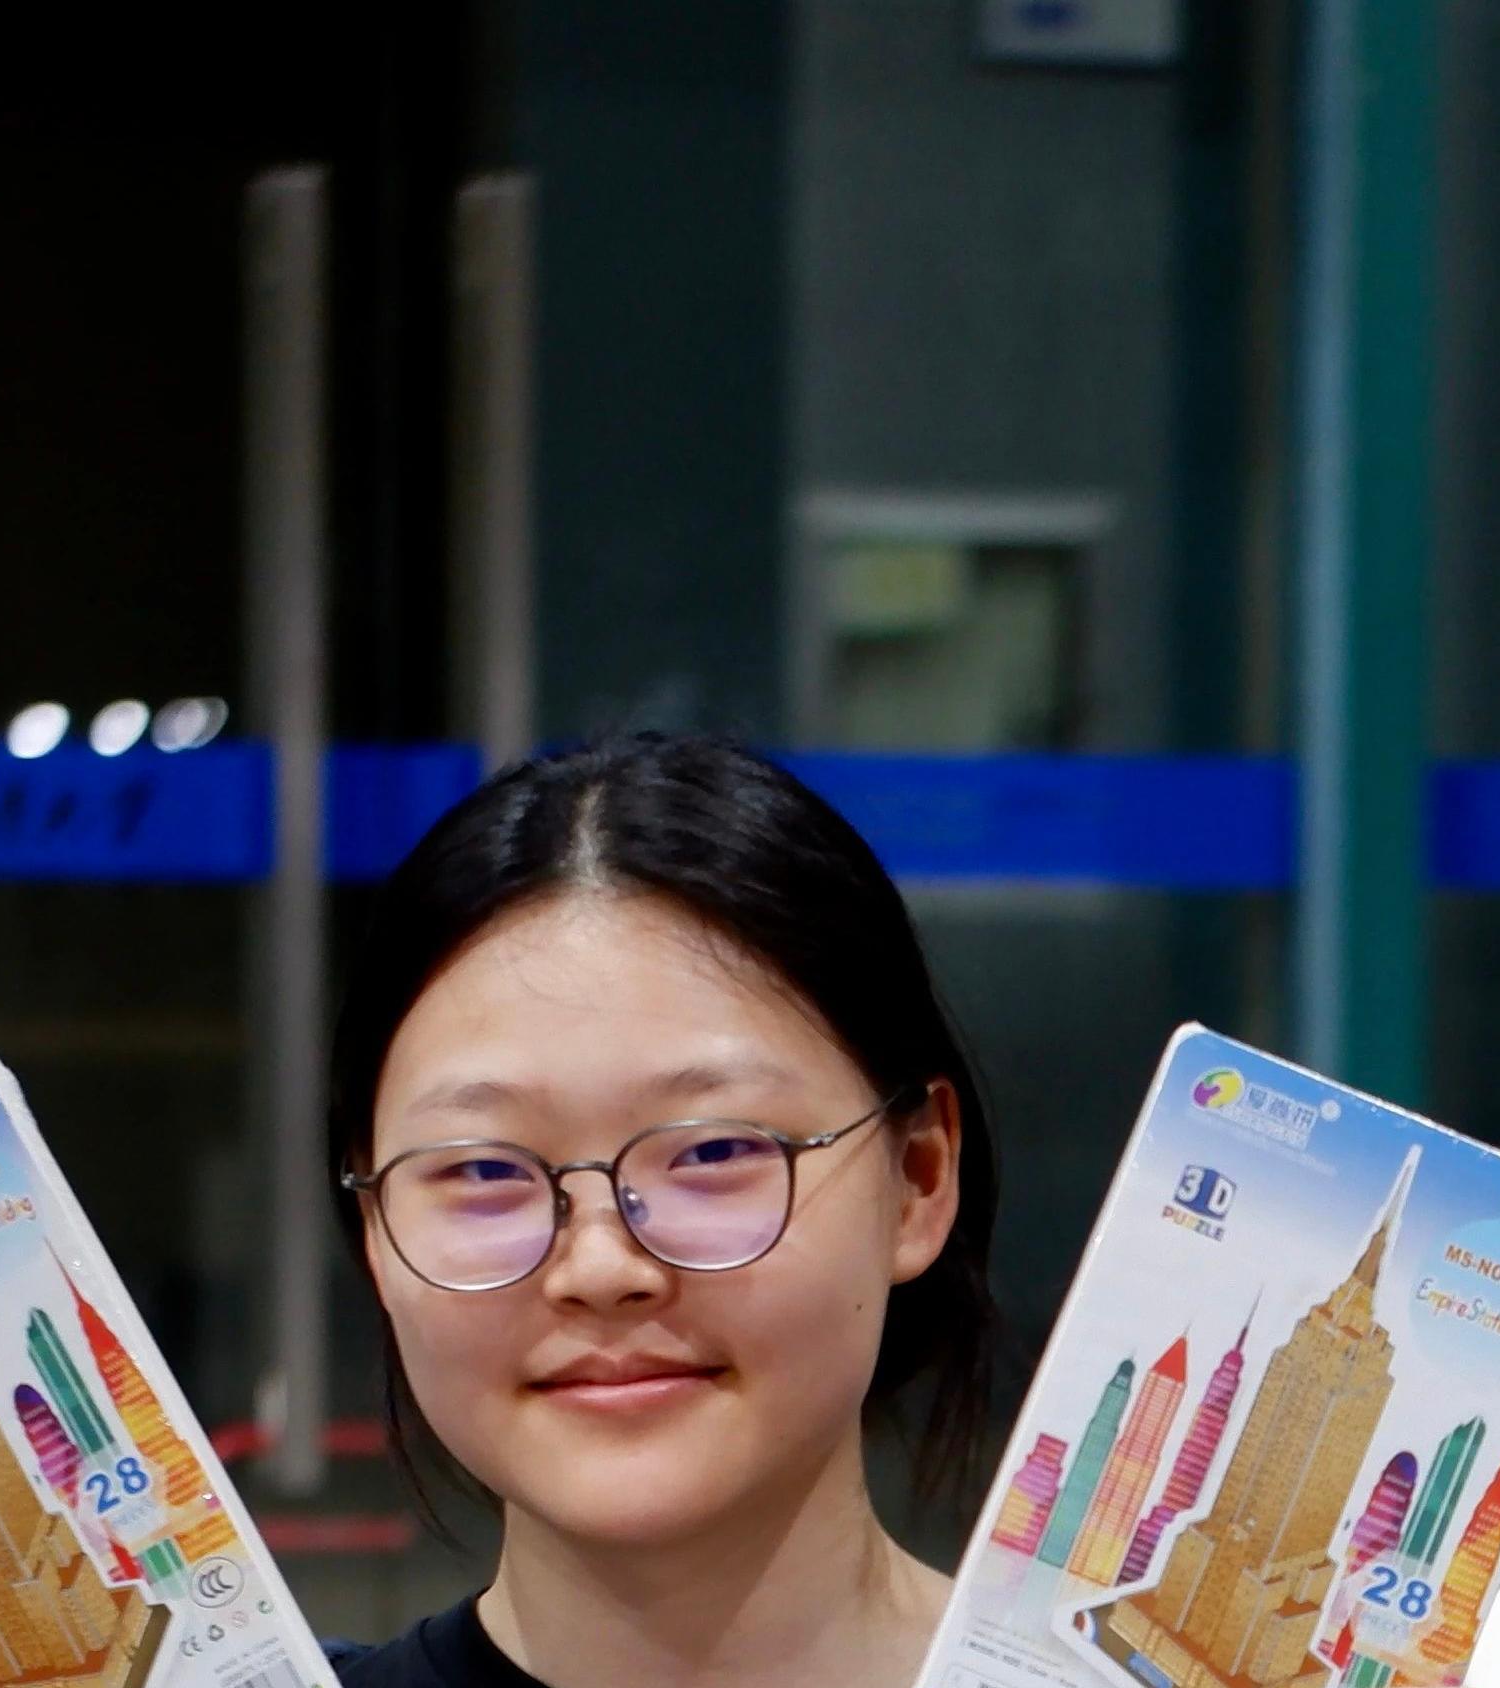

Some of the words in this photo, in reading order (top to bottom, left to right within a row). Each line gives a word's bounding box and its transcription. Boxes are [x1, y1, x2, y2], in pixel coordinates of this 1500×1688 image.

[1176, 1164, 1236, 1220] 3D
[85, 1457, 149, 1514] 28
[1362, 1566, 1432, 1619] 28
